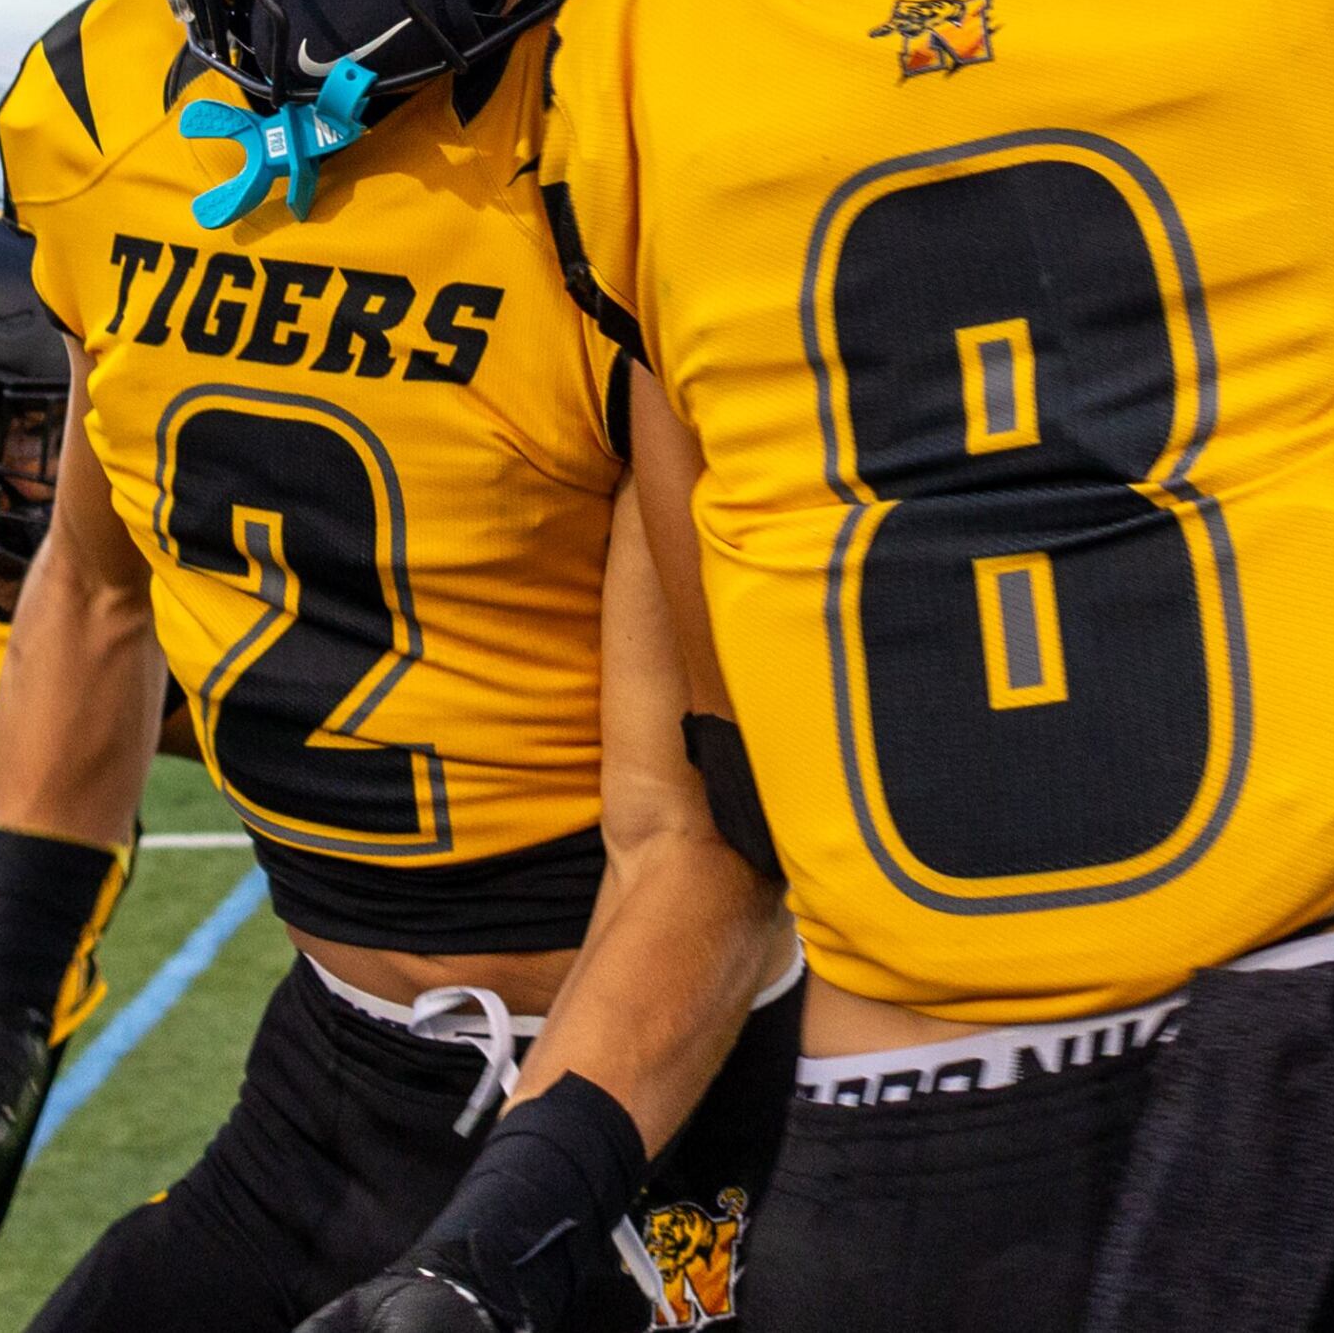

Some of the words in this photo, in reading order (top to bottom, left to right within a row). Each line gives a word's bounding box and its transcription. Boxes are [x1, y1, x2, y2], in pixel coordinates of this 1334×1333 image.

[105, 233, 505, 386] TIGERS
[800, 128, 1253, 915] 8
[154, 383, 453, 853] 2
